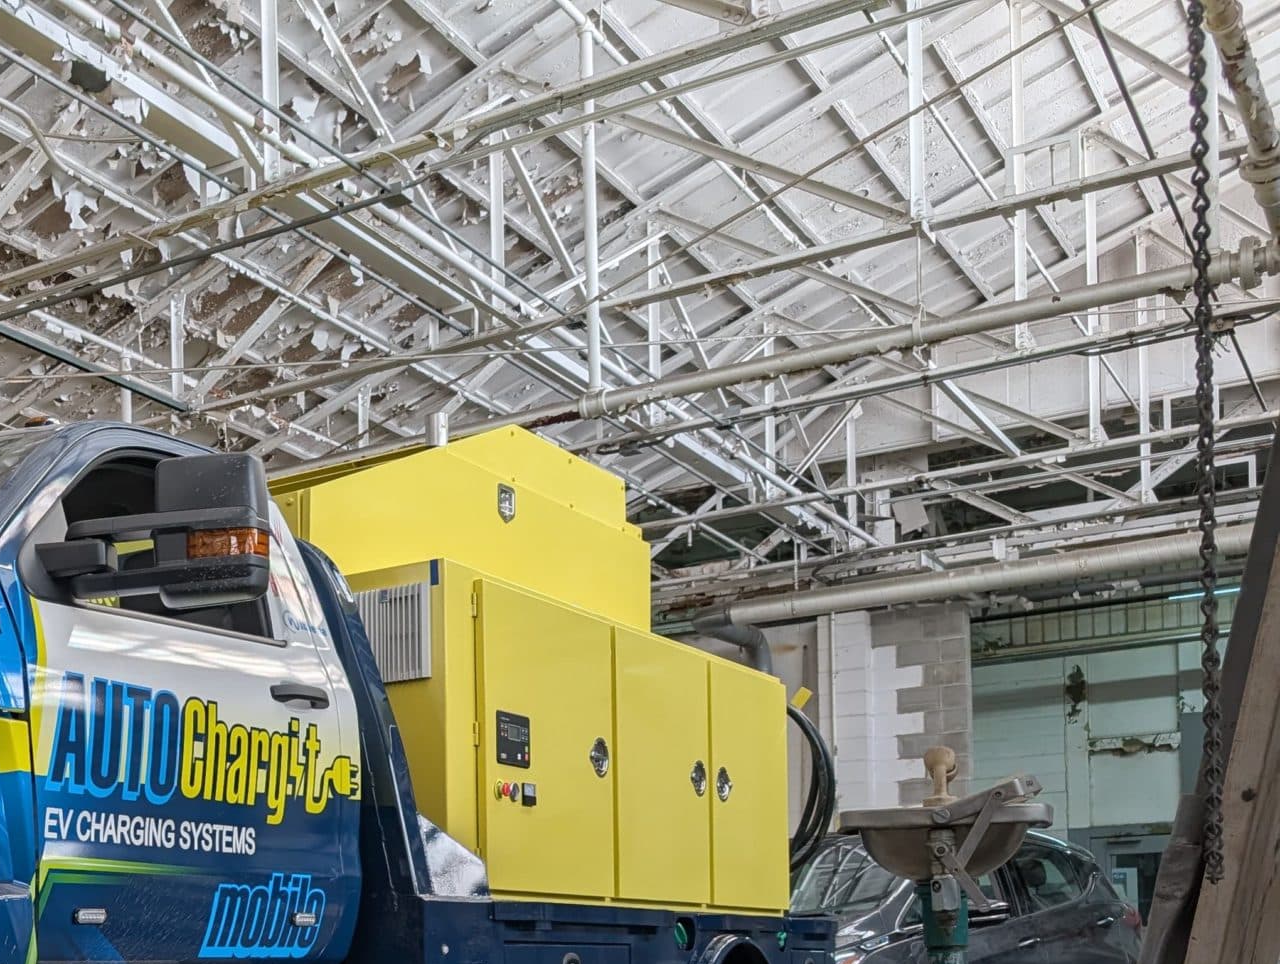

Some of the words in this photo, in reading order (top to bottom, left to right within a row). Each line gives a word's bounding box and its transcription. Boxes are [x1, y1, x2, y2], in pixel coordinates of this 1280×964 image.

[44, 806, 74, 840] EV
[76, 810, 176, 850] CHARGING
[179, 820, 257, 856] SYSTEMS
[198, 872, 325, 959] mobile
